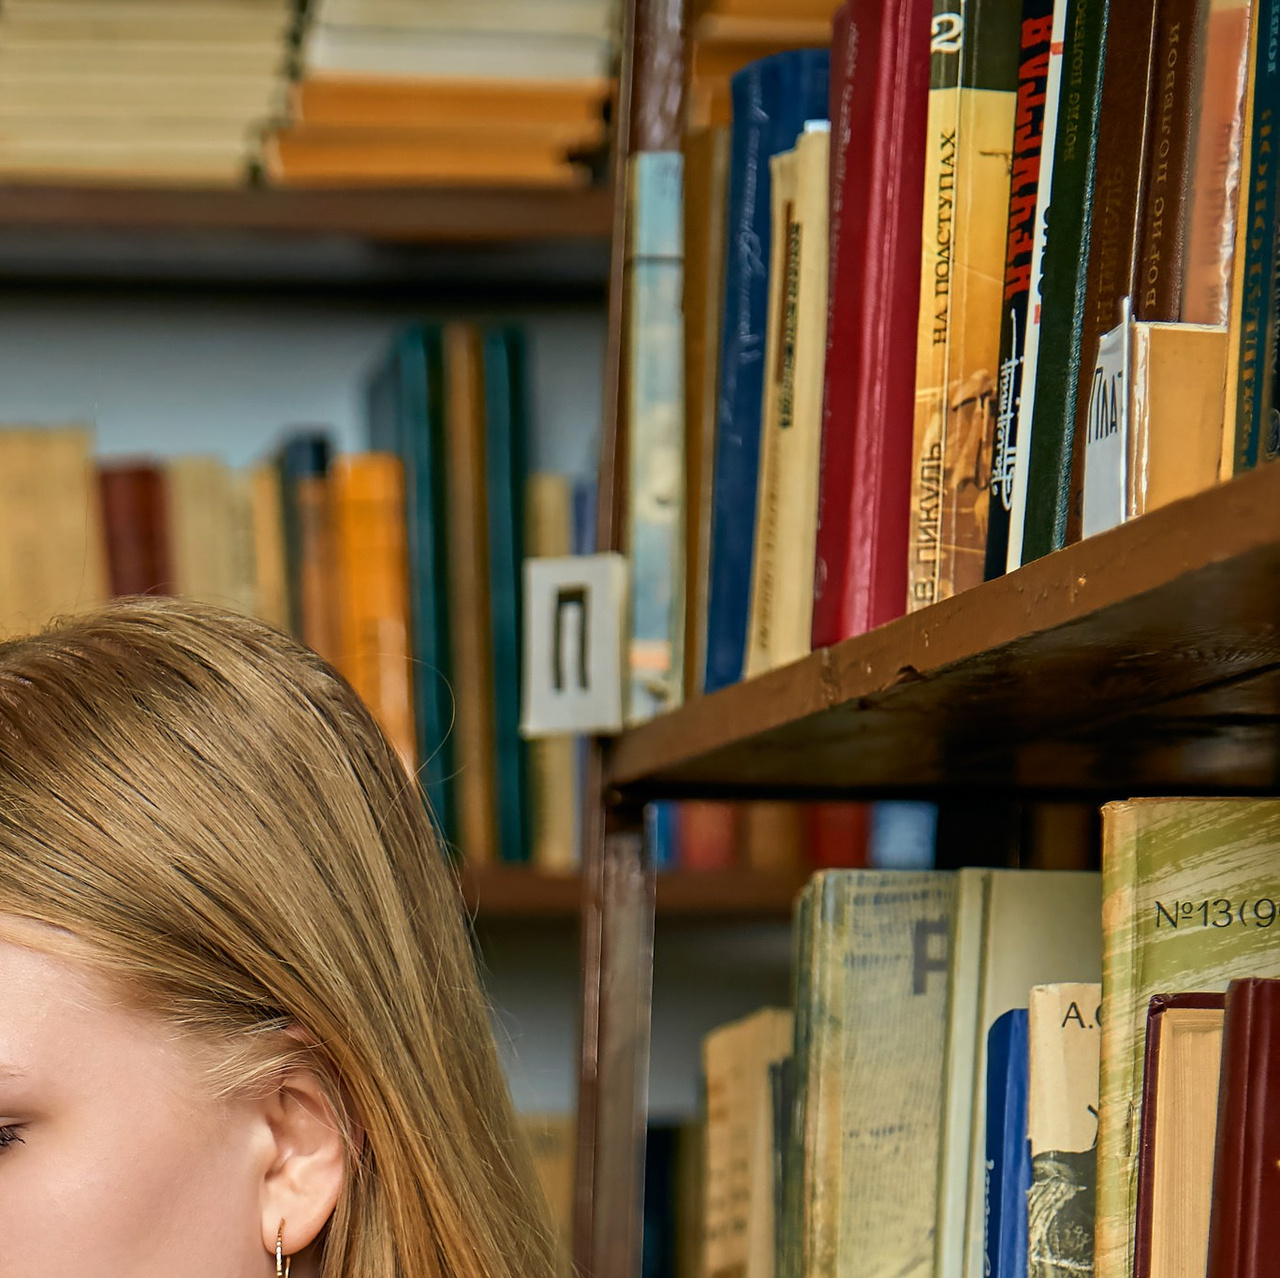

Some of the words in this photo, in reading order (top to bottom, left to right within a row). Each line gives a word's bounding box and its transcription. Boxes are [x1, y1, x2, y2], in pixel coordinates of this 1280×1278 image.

[931, 12, 963, 53] 2
[934, 129, 956, 298] ПОДСТУПАХ
[1004, 14, 1053, 301] НЕЧИСТАЯ
[1145, 195, 1164, 308] БОРИС
[1156, 22, 1181, 184] ПОЛЕВОЙ
[933, 308, 948, 345] НА
[917, 442, 942, 561] ПИКУЛЬ
[553, 586, 589, 691] П
